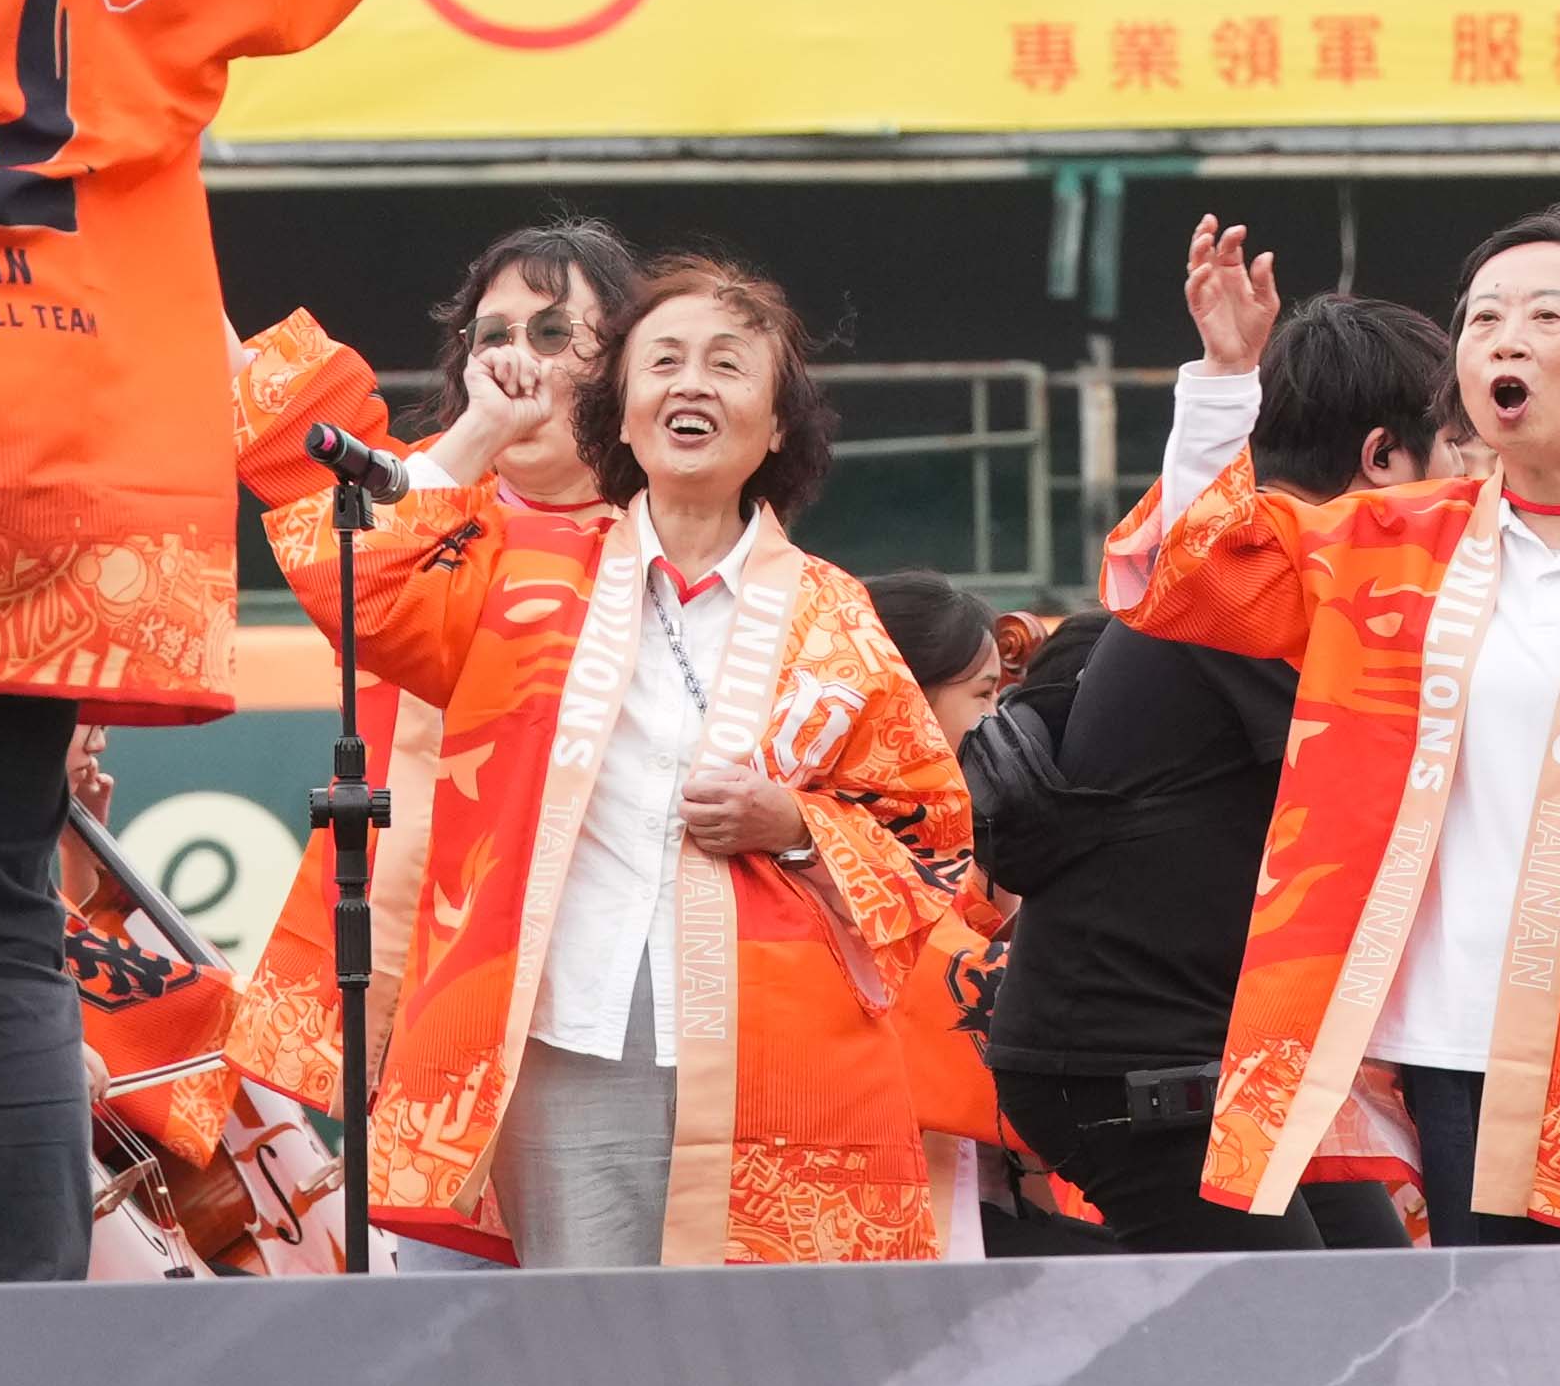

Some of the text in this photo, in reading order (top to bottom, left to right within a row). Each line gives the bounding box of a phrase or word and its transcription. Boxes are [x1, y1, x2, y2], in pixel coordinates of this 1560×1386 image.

[1009, 16, 1385, 94] 專業領軍
[1408, 535, 1496, 793] UNILIONS
[1337, 819, 1433, 1009] TAINAN
